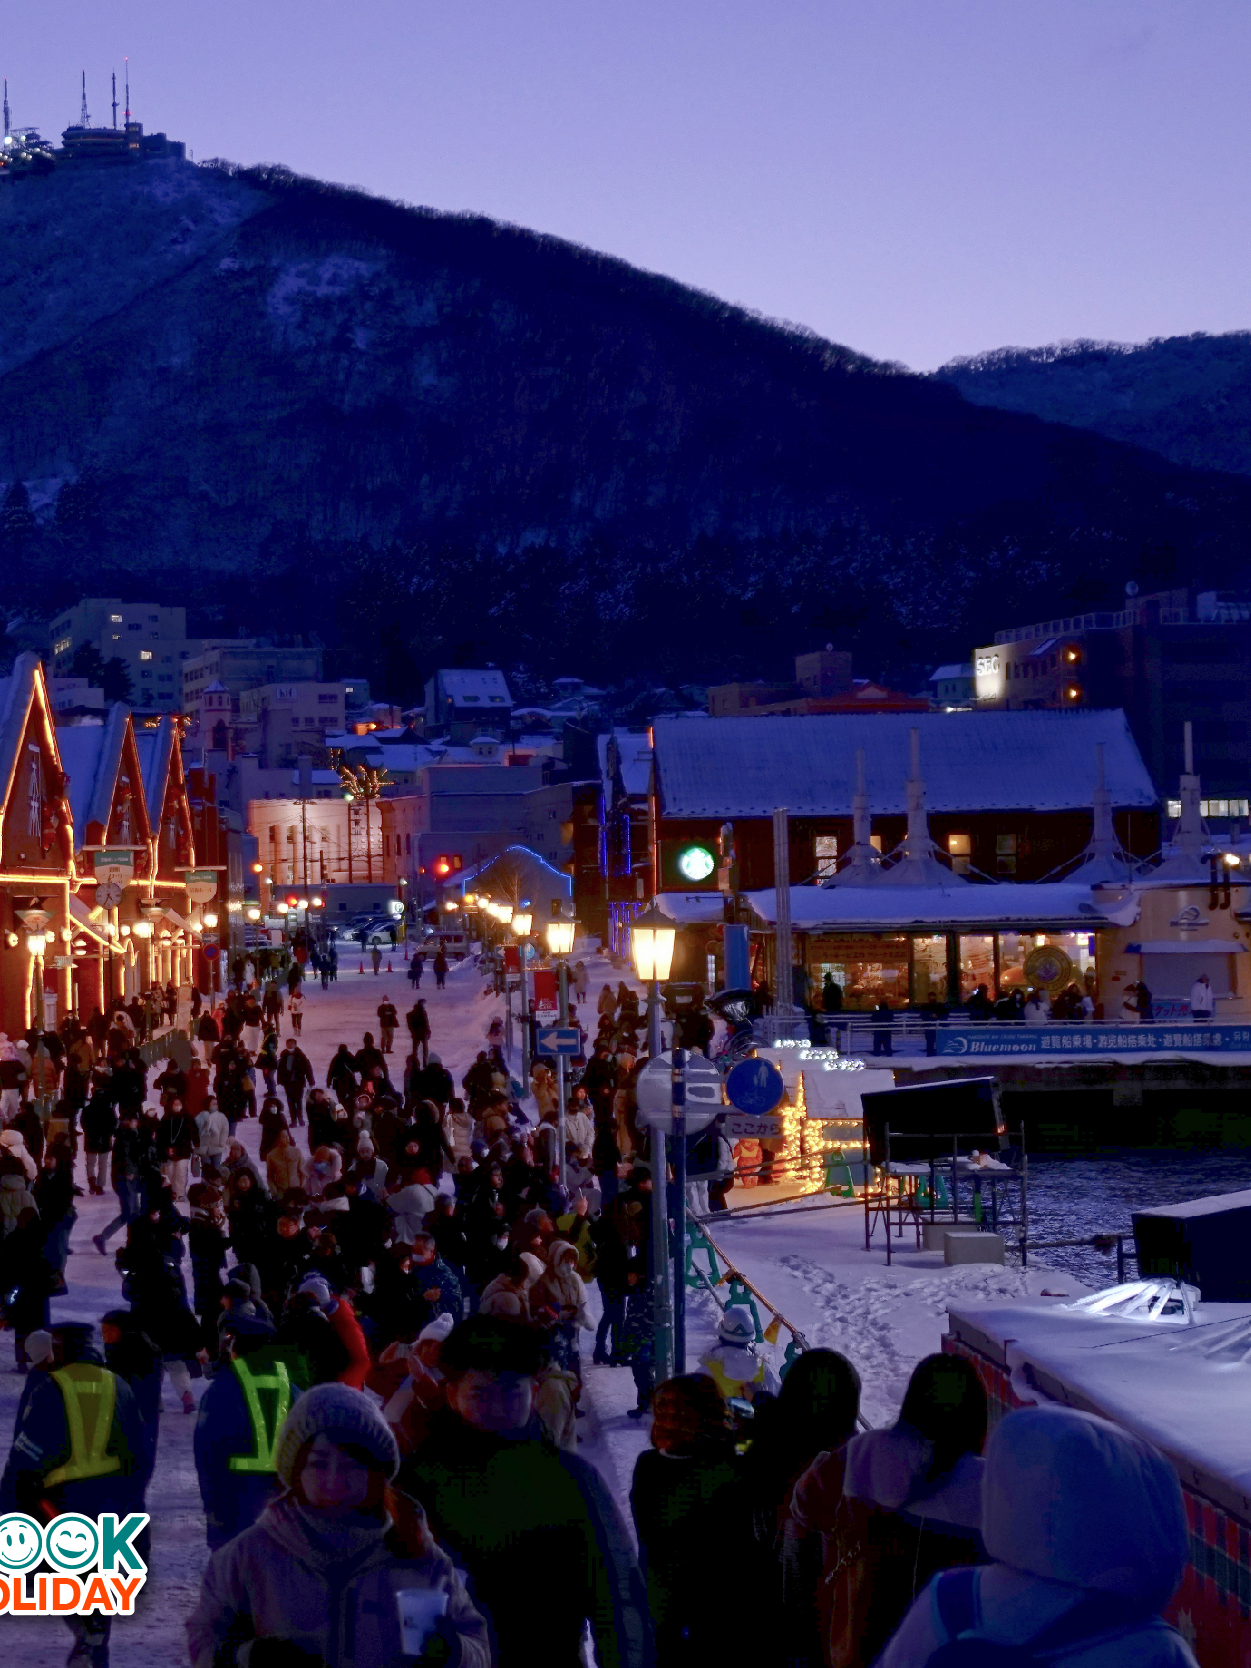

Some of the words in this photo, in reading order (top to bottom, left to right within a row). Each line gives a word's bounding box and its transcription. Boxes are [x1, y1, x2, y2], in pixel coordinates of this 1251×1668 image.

[970, 1041, 1036, 1052] Bluemoon
[732, 1122, 781, 1135] ここから
